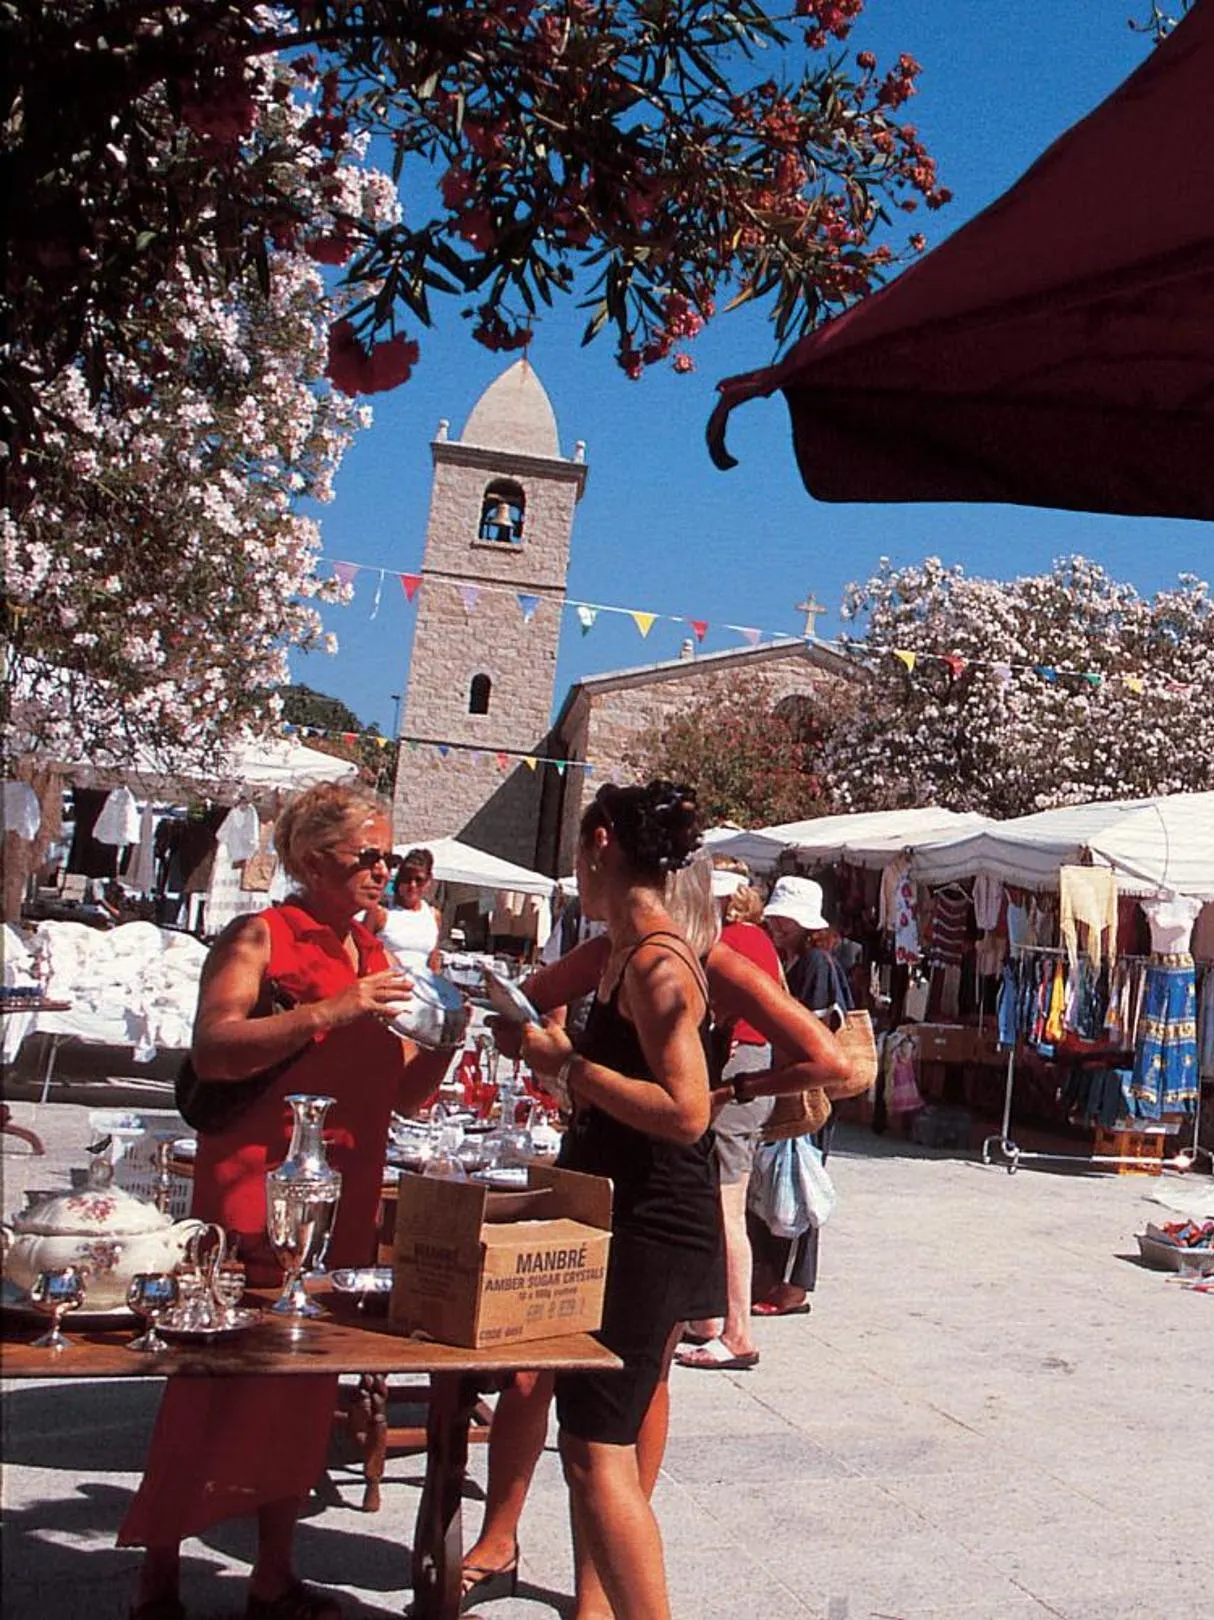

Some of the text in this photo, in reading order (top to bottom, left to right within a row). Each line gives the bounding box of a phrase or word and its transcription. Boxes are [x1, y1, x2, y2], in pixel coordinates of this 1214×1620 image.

[516, 1242, 588, 1274] MANBRÉ
[485, 1277, 525, 1291] AMBER
[528, 1273, 560, 1288] SUGAR
